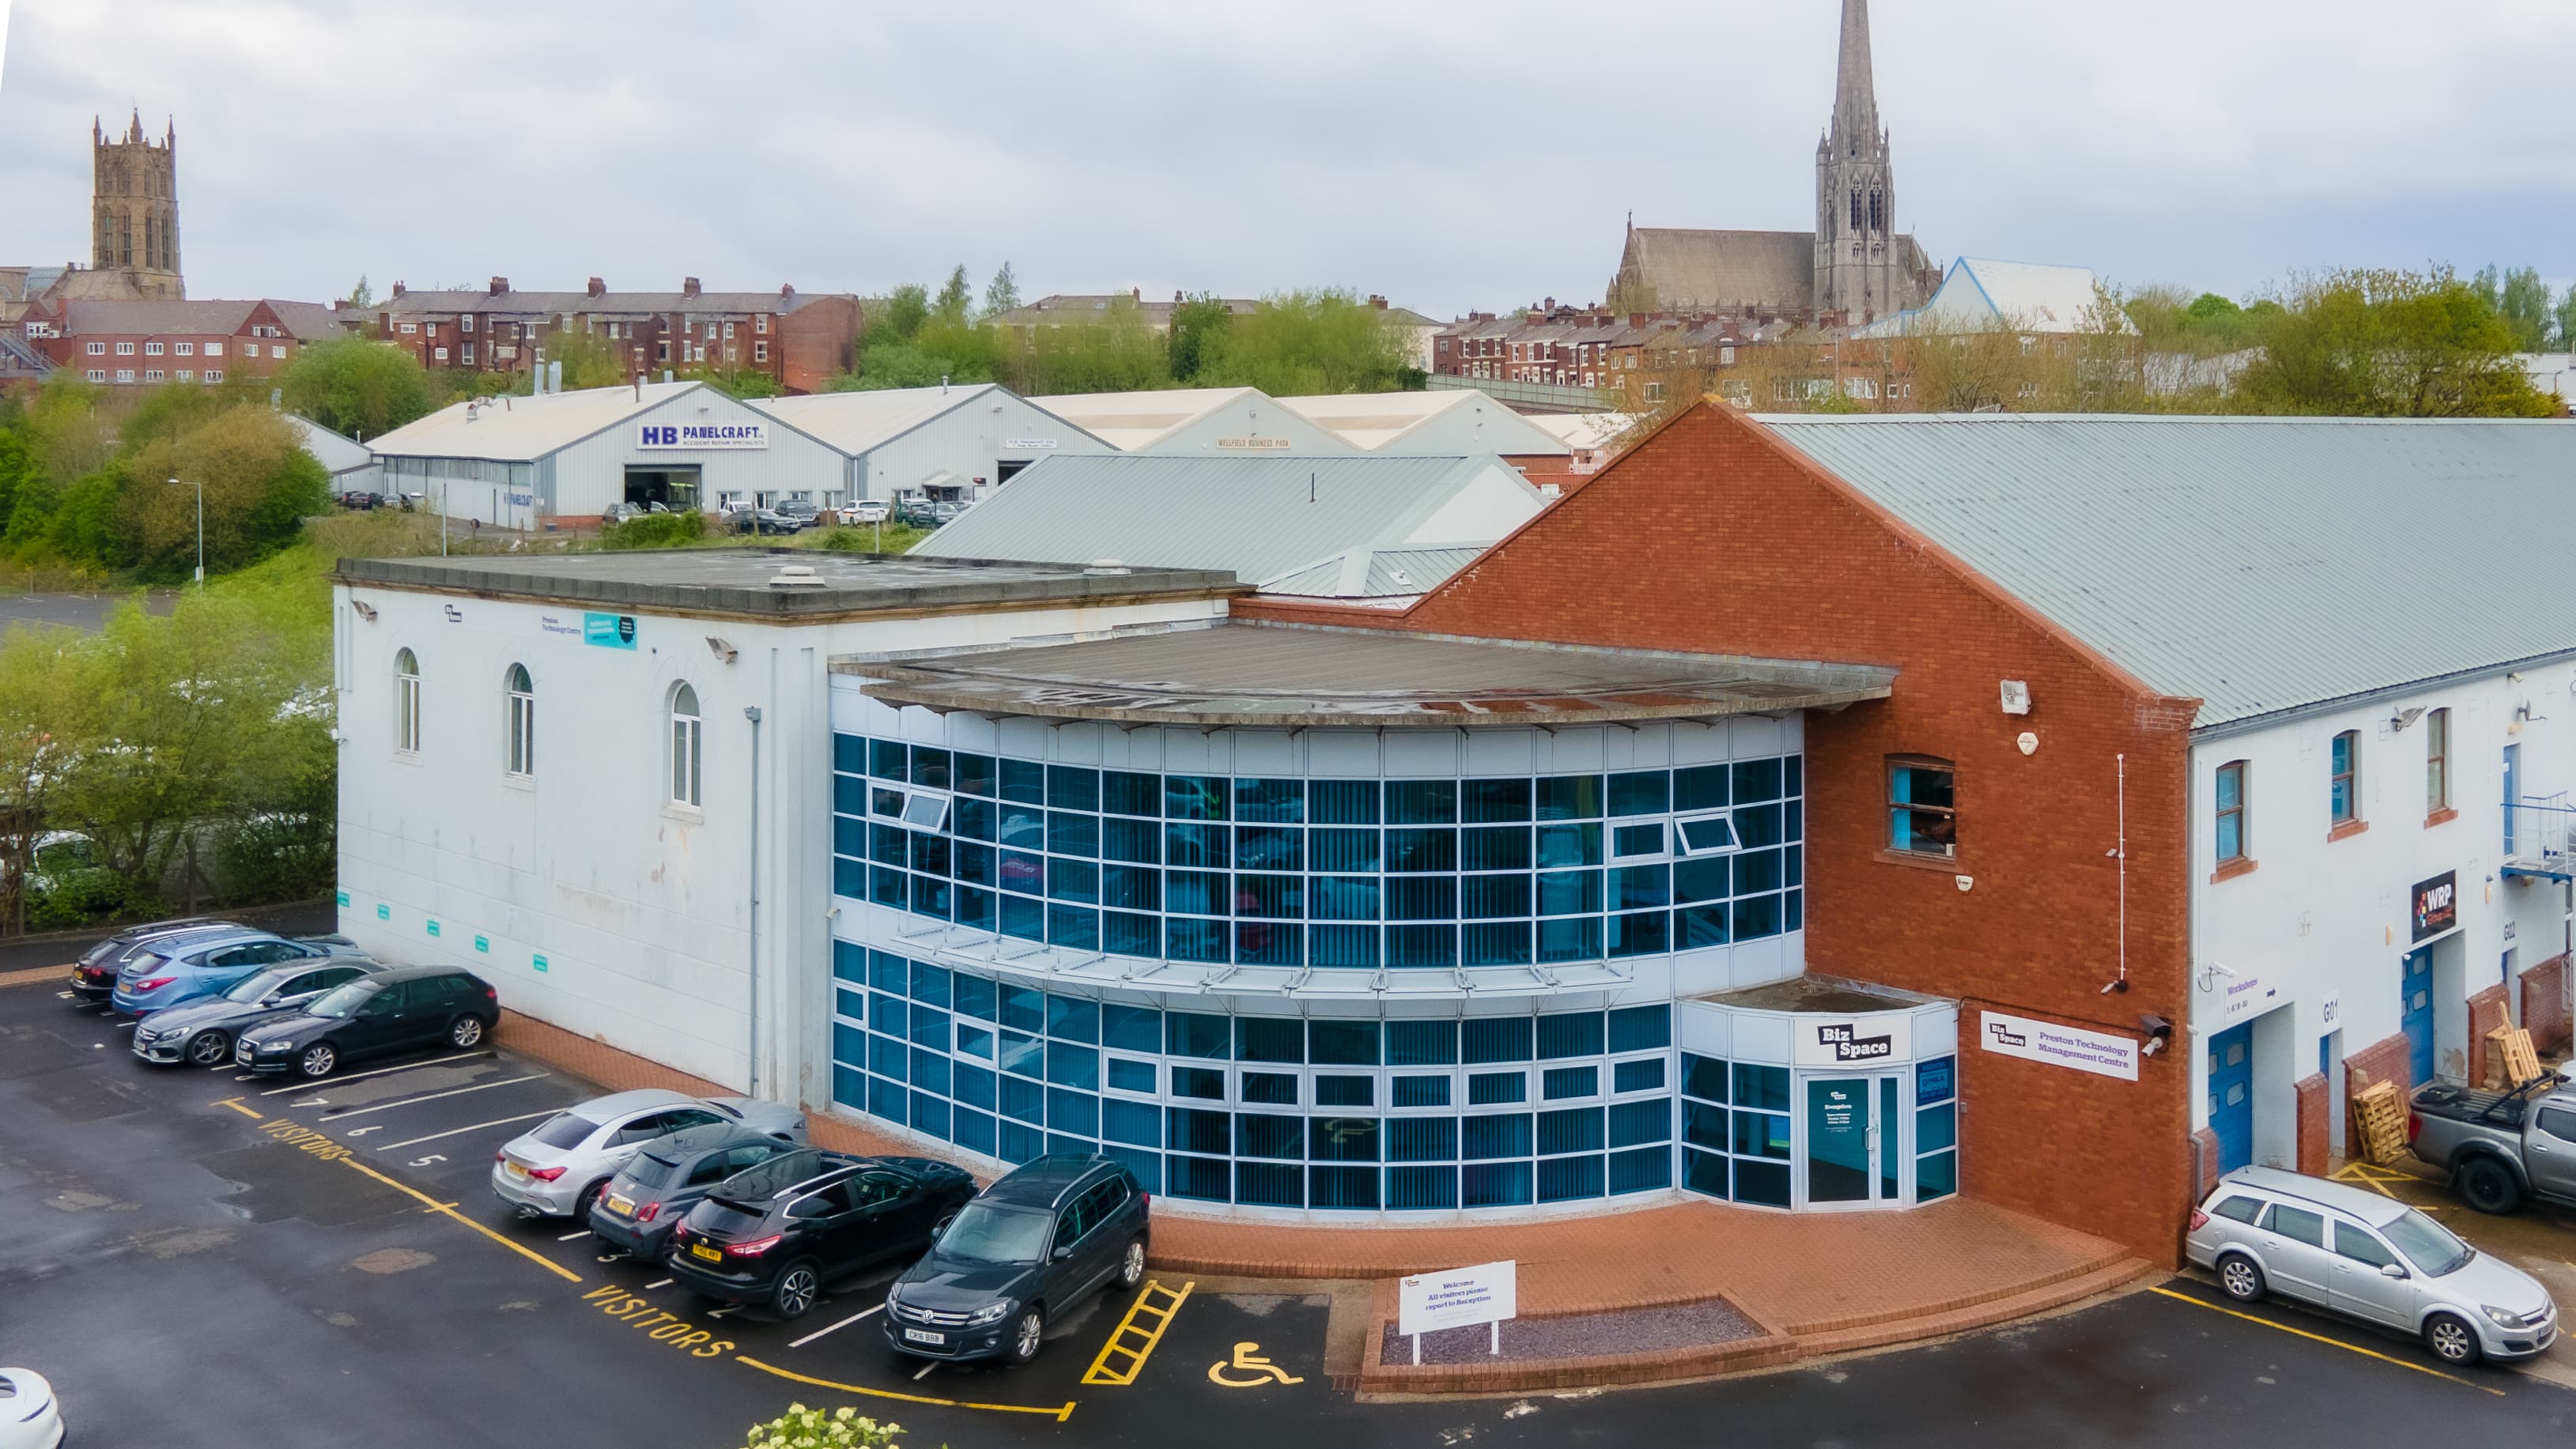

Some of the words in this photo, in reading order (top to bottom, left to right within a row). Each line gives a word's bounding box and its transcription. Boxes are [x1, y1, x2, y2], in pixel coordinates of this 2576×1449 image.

[642, 426, 678, 445] HB
[683, 426, 760, 439] PANELCRAFT
[2427, 884, 2452, 911] WRP
[2504, 920, 2515, 941] G02
[2227, 978, 2258, 996] Workshops
[2323, 998, 2339, 1023] G01
[1822, 1028, 1850, 1042] Biz
[1992, 1024, 2005, 1033] Biz
[1999, 1034, 2024, 1047] Space
[2039, 1032, 2075, 1046] Preston
[2075, 1040, 2129, 1058] Technology
[1840, 1041, 1888, 1058] Space
[2038, 1043, 2097, 1062] Management
[2098, 1055, 2129, 1069] Centre
[290, 1097, 330, 1108] 7
[258, 1118, 353, 1160] VISITORS
[347, 1126, 383, 1137] 6
[408, 1154, 448, 1167] 5
[1443, 1280, 1475, 1289] Welcome
[1440, 1291, 1465, 1300] visitors
[1466, 1287, 1488, 1296] please
[1426, 1302, 1448, 1311] report
[1456, 1295, 1491, 1306] Reception
[581, 1285, 735, 1357] VISITORS
